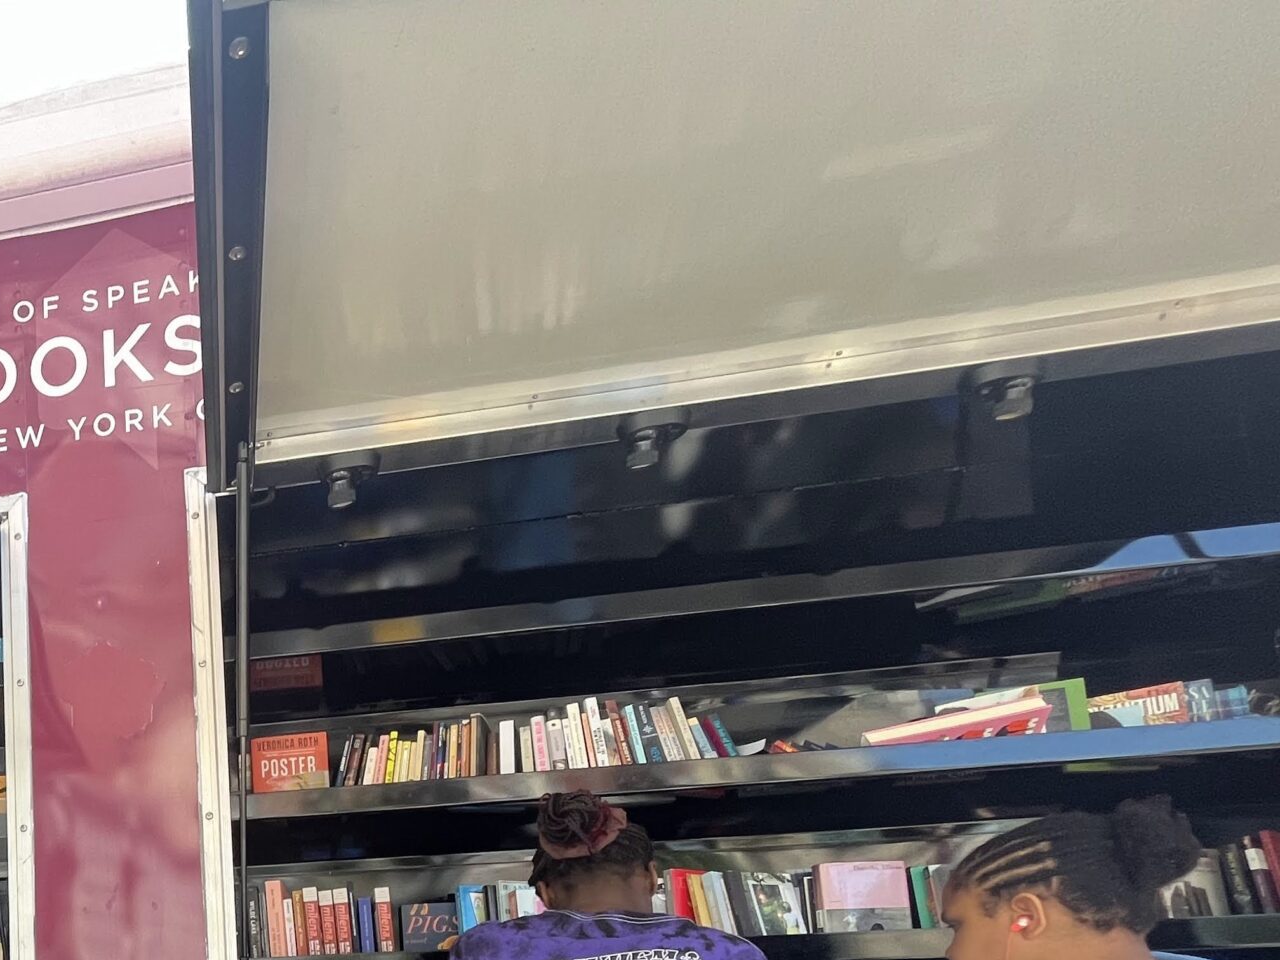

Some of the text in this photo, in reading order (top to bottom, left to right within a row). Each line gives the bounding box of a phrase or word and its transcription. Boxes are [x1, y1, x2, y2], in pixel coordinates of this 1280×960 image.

[12, 296, 60, 323] OF
[67, 403, 172, 440] YORK
[256, 736, 319, 752] VERONICA ROTH
[261, 755, 317, 778] POSTER
[407, 914, 459, 934] PIGS
